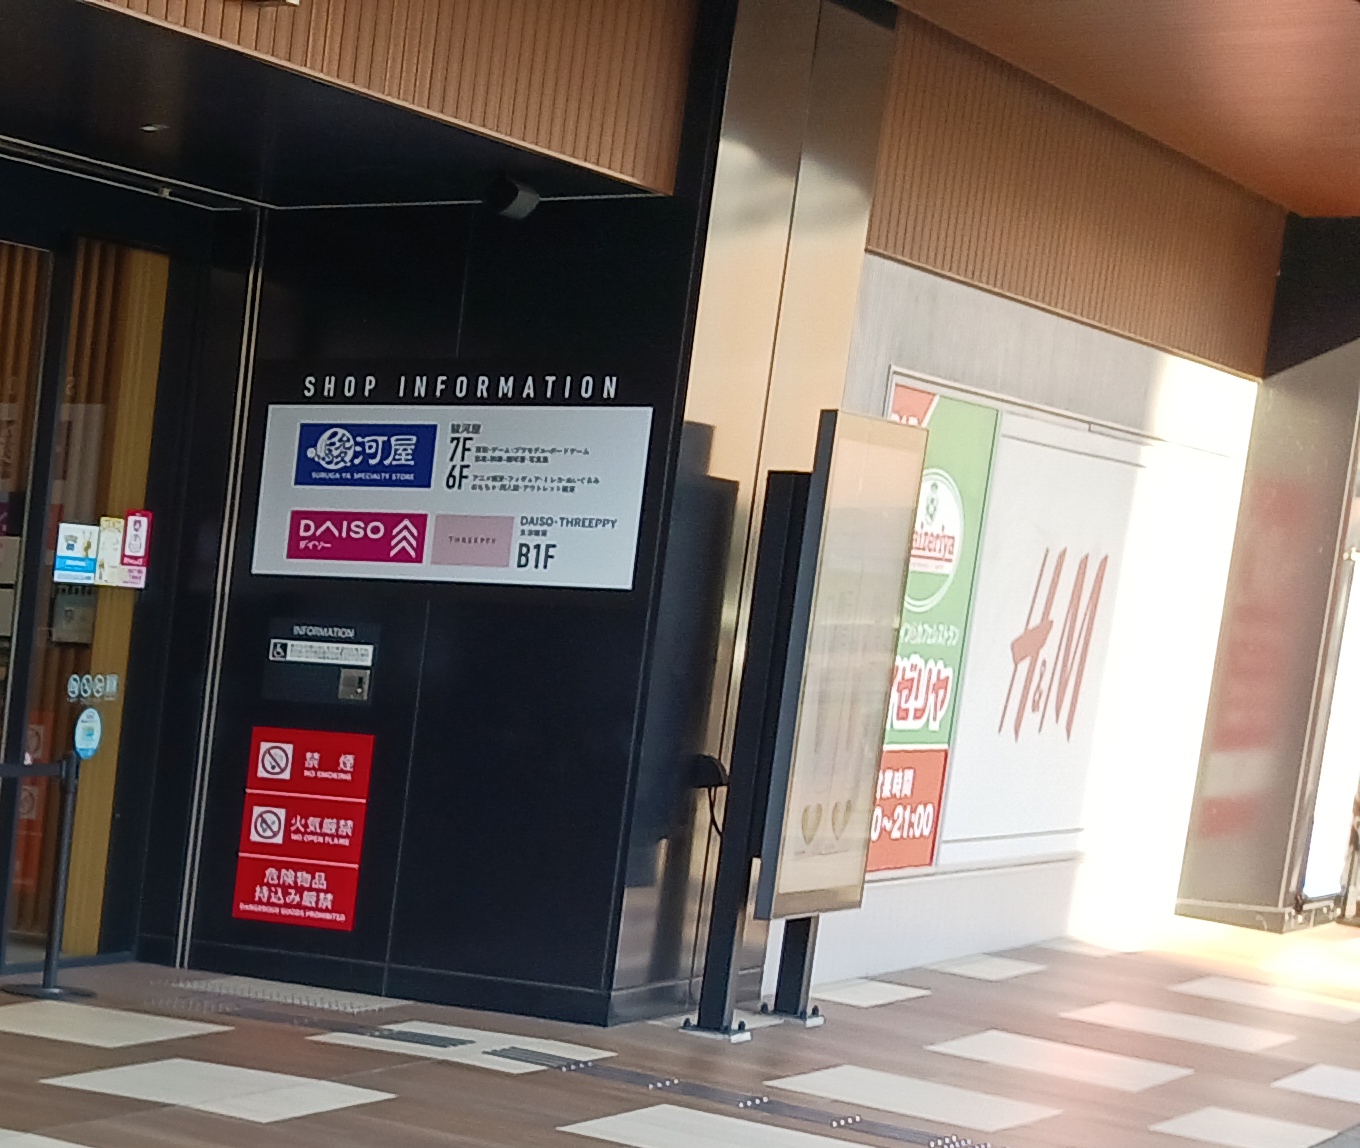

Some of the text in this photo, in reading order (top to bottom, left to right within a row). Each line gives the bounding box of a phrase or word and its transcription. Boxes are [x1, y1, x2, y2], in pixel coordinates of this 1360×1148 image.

[303, 375, 617, 399] SHOP INFORMATION
[307, 427, 418, 470] 駿河屋
[449, 436, 474, 463] 7F
[445, 464, 471, 491] 6F
[299, 519, 385, 539] DAISO
[516, 543, 557, 569] B1F
[293, 626, 355, 638] INFORMATION
[998, 547, 1109, 743] H&M
[892, 656, 953, 730] ゼリヤ
